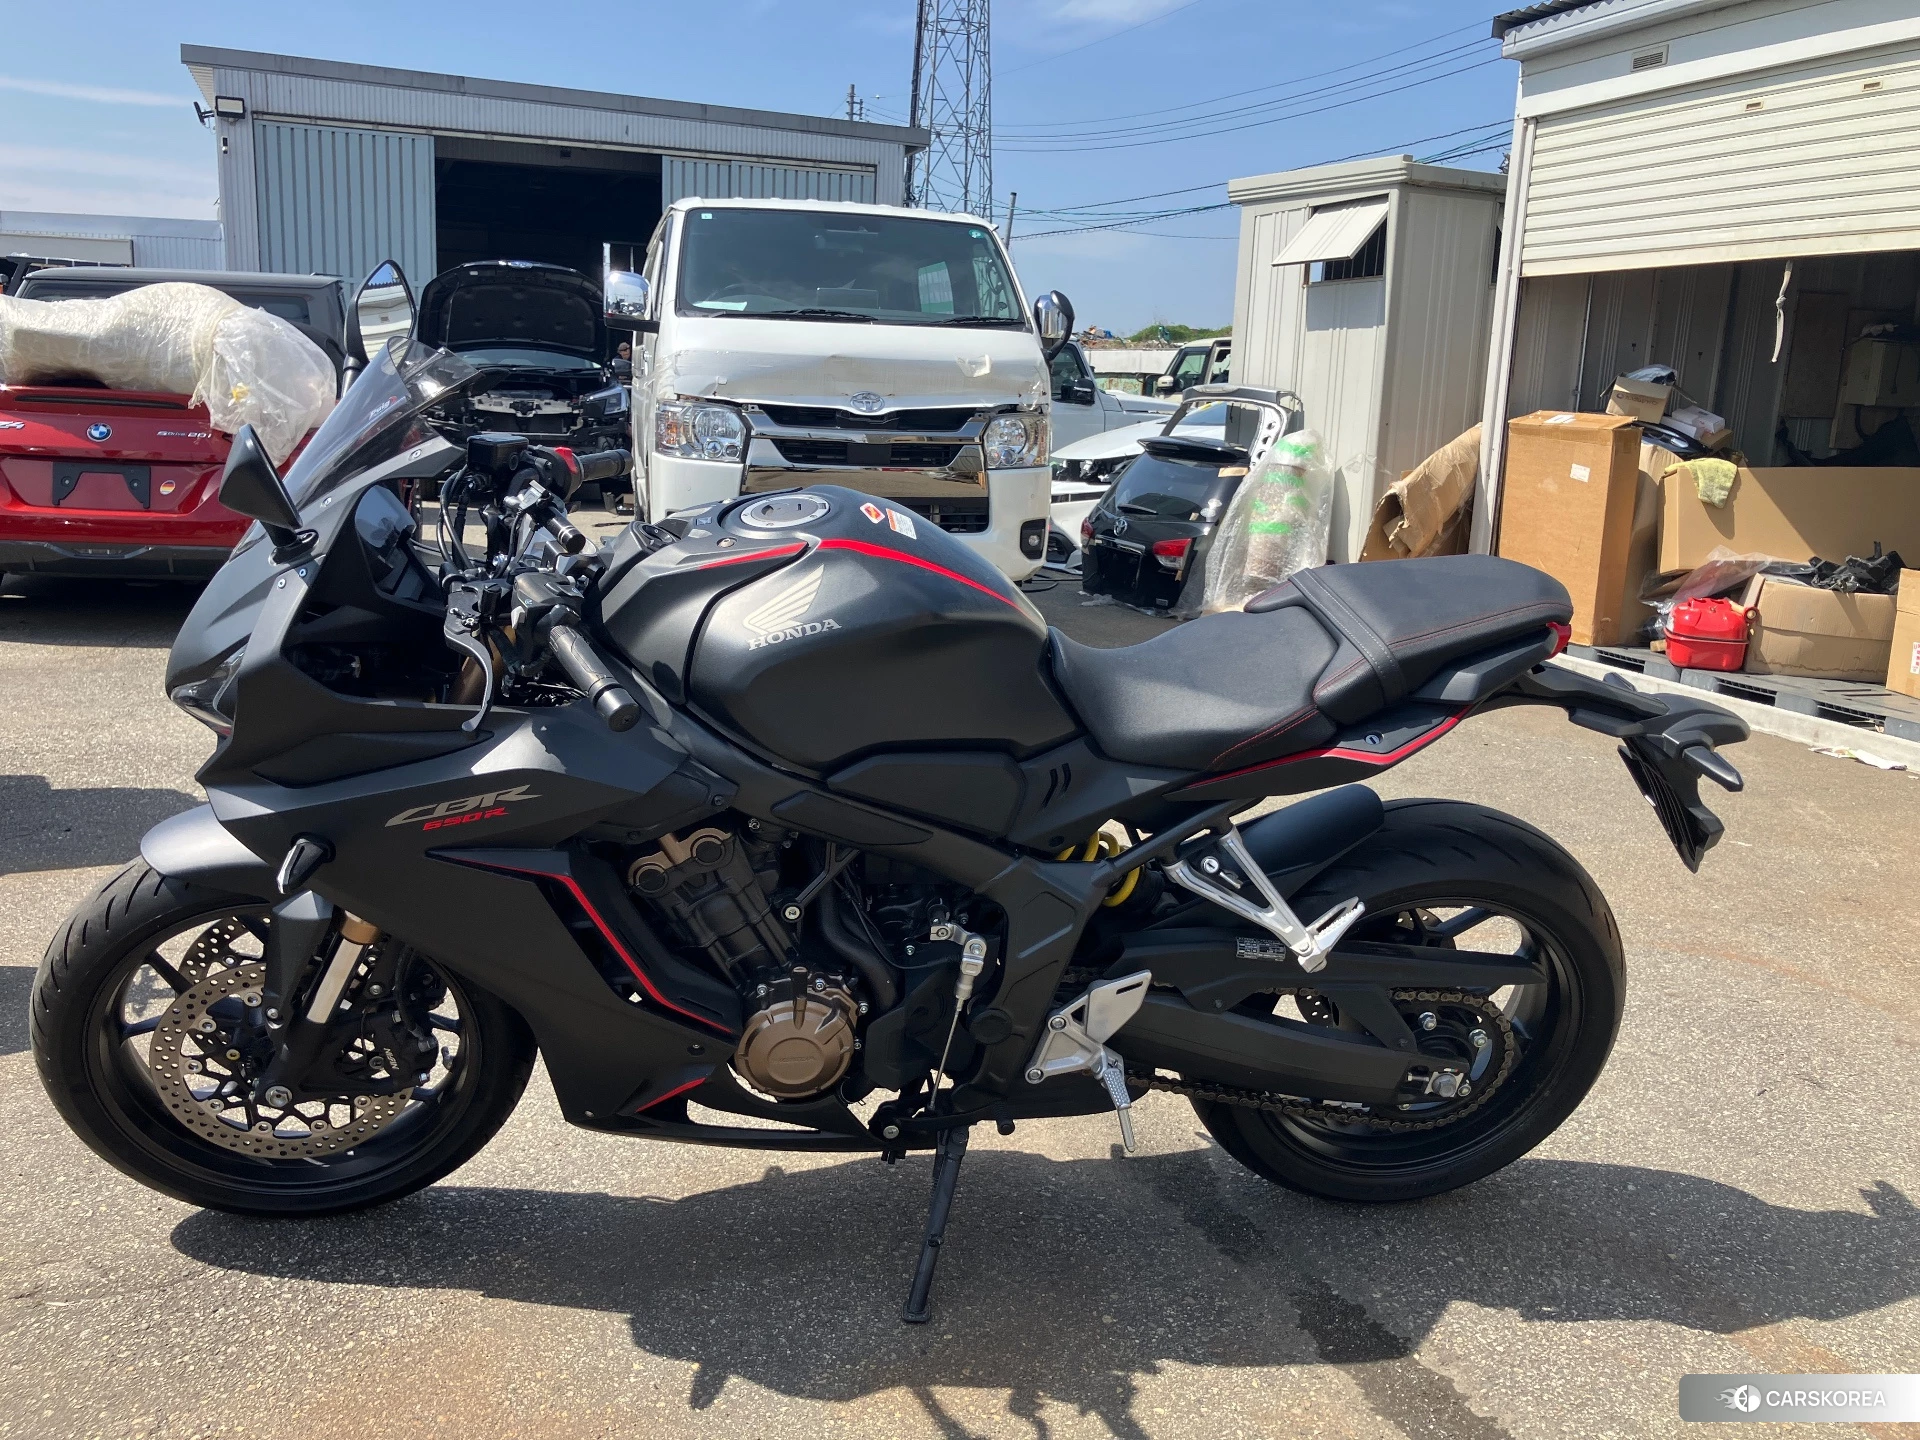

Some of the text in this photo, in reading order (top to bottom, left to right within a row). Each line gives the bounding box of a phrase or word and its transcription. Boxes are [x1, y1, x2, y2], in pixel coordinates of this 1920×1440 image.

[746, 618, 842, 651] HONDA
[384, 784, 543, 828] CBR
[422, 806, 510, 831] 650R
